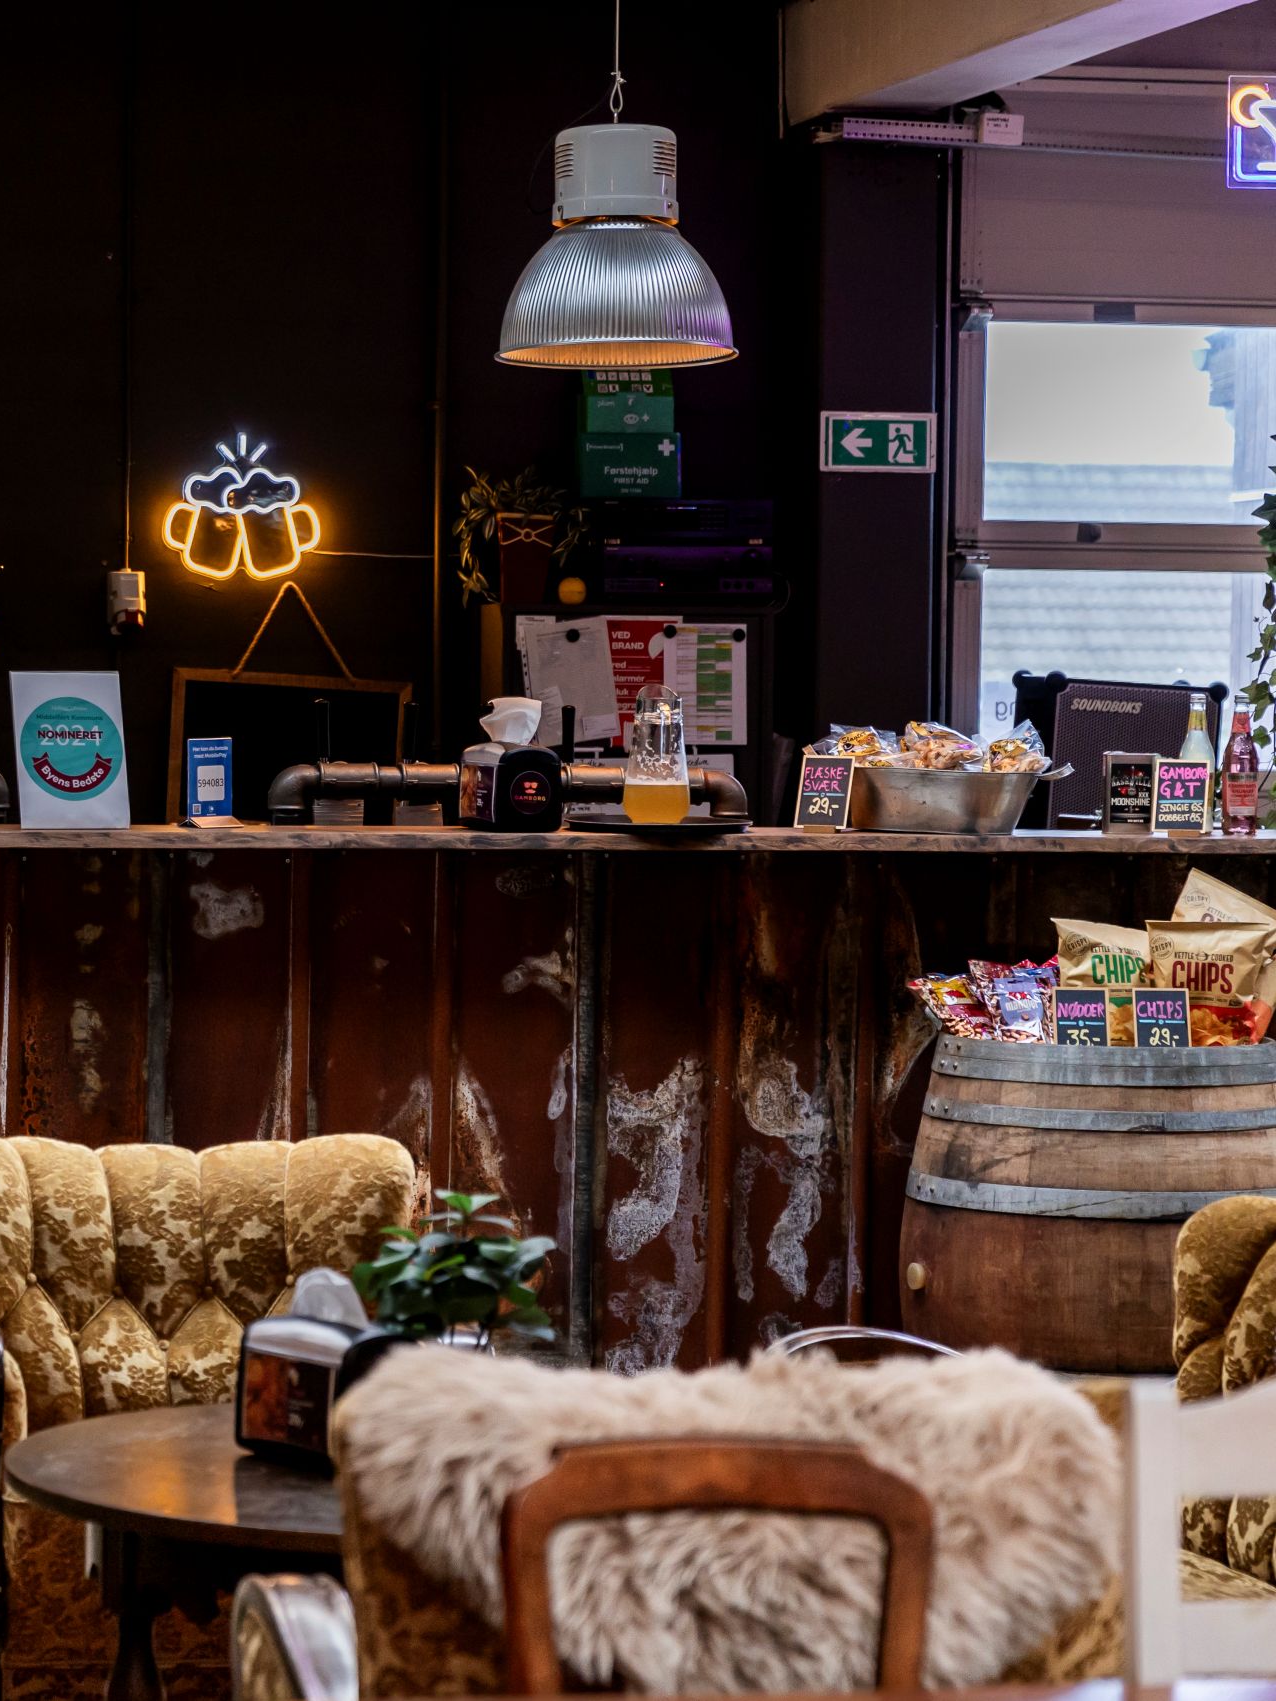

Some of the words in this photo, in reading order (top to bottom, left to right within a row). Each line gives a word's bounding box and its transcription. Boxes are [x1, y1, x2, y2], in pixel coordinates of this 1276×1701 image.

[604, 466, 658, 477] Førstehjælp
[1071, 698, 1143, 714] SOUNDBOKS
[37, 730, 103, 739] NOMINERET
[41, 765, 70, 787] Byens
[73, 768, 104, 788] Bedste
[805, 767, 848, 779] FLÆSKE-
[1160, 766, 1208, 780] GAMBORG
[804, 780, 841, 792] SVÆR
[1111, 798, 1150, 806] MOONSHINE
[1067, 938, 1087, 951] CRISPY
[1151, 941, 1172, 953] CRISPY
[1211, 954, 1234, 962] COOKED
[1092, 955, 1146, 984] CHIPS
[1172, 960, 1234, 994] CHIPS
[1057, 1002, 1105, 1020] NØDDER
[1137, 1001, 1183, 1019] CHIPS
